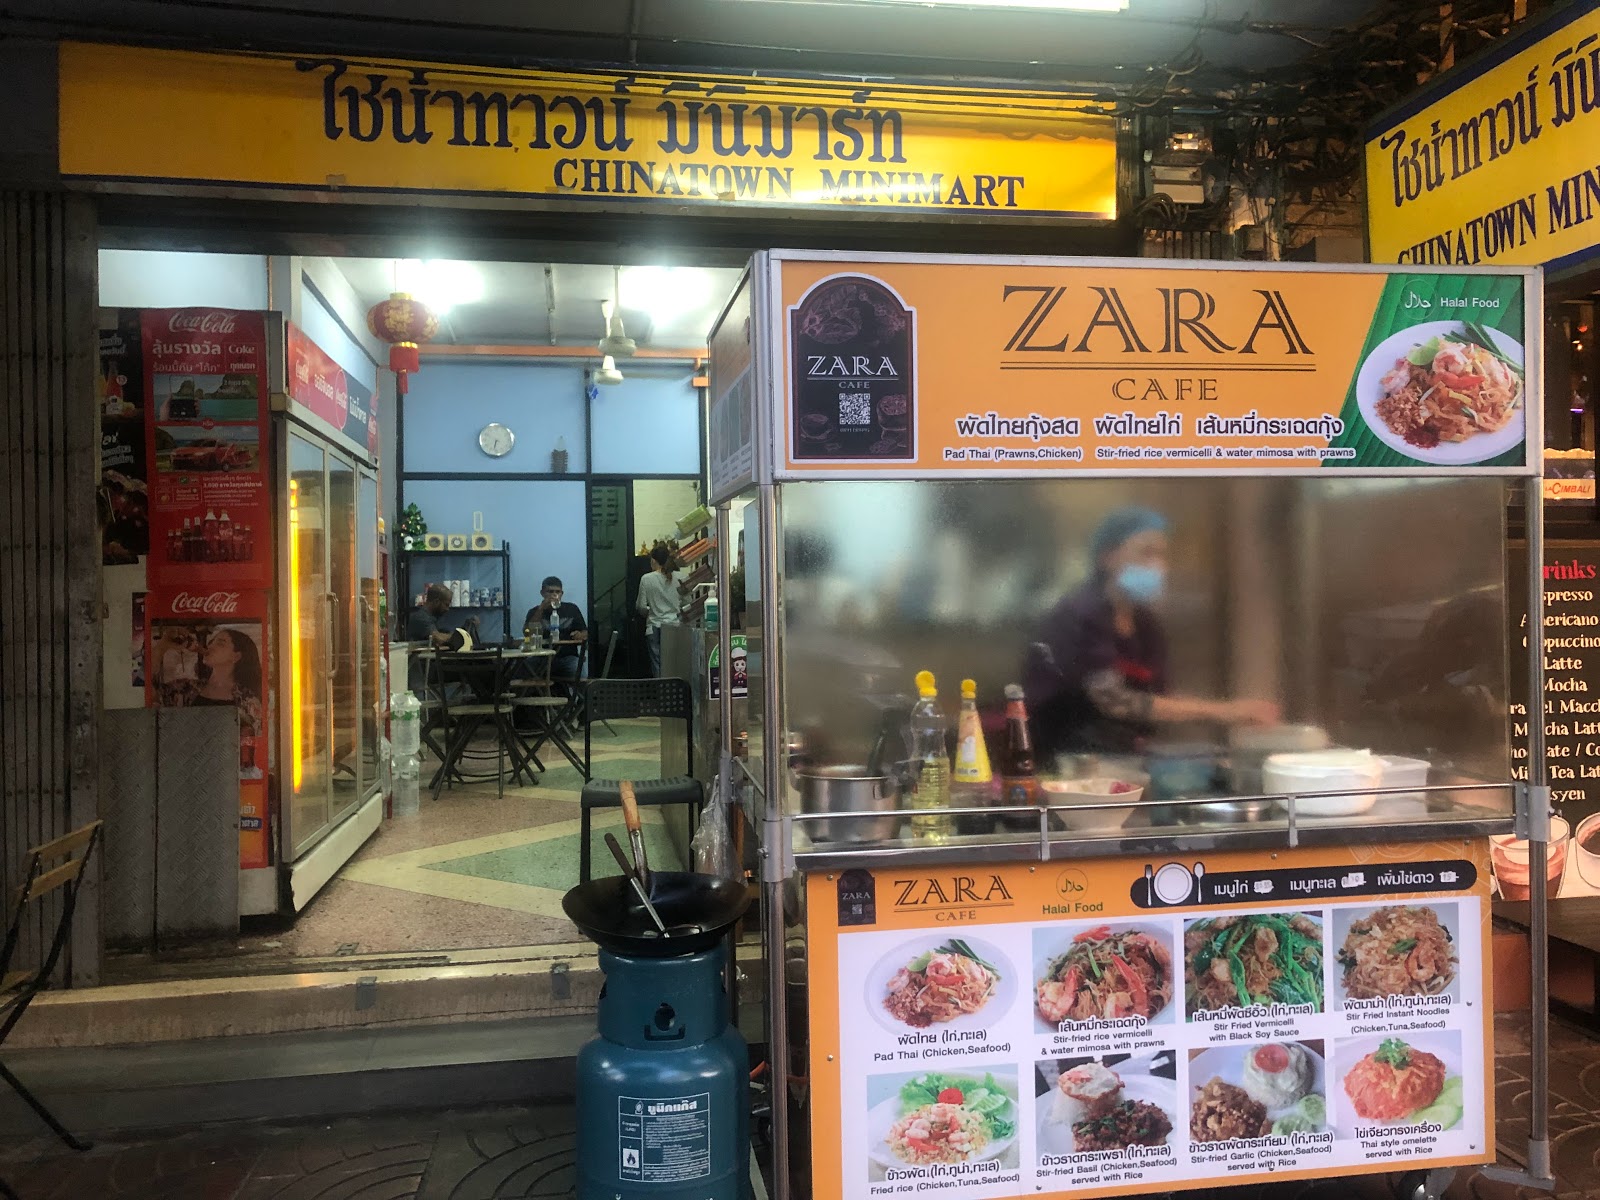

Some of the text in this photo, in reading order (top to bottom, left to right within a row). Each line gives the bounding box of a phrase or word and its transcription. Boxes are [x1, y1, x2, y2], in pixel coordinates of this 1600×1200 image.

[295, 58, 907, 163] ไชน่าทาวน์ มินิมาร์ท
[1380, 64, 1543, 208] ไชน่าทาวน์
[553, 157, 1025, 208] CHINATOWN MINIMART
[1440, 297, 1500, 309] Halal Food
[169, 311, 240, 334] Coca-Cola
[1002, 284, 1316, 355] ZARA
[152, 339, 222, 358] ลุ้นรางวัล
[228, 344, 256, 355] Coke
[806, 355, 899, 376] ZARA
[838, 381, 871, 389] CAFE
[1111, 377, 1219, 401] CAFE
[957, 411, 1343, 440] ผัดไทยกุ้งสด ผัดไทยไก่ เส้นหมี่กระเฉดกุ้ง
[944, 448, 1082, 461] Pad Thai (Prawns,Chicken)
[1096, 448, 1354, 459] Stir-fried rice vermicelli & water mimosa with prawns
[1543, 559, 1597, 580] rinks
[171, 592, 240, 613] Coca-Cola
[1543, 590, 1594, 607] presso
[1520, 613, 1599, 628] ericano
[1522, 634, 1600, 653] puccino
[1544, 656, 1583, 671] Latte
[1513, 721, 1570, 737] Mcha
[1575, 742, 1581, 757] /
[1549, 765, 1576, 779] Tea
[1550, 788, 1586, 803] syen
[893, 874, 1014, 906] ZARA
[1214, 879, 1249, 898] เมนูไก่
[1289, 878, 1337, 894] เมนูทะเล
[1377, 869, 1435, 886] เพิ่มไข่ดาว
[842, 890, 871, 901] ZARA
[935, 910, 977, 922] CAFE
[1042, 901, 1104, 915] Halal Food
[1271, 1003, 1314, 1018] (ไก่,ทะเล)
[1344, 996, 1384, 1010] ผัดมาม่า
[1346, 1007, 1450, 1021] Stir Fried Instant Noodles
[1060, 1016, 1147, 1033] เส้นหมี่กระเฉดกุ้ง
[1213, 1018, 1295, 1031] Stir Fried Vermicelli
[1350, 1020, 1446, 1034] (Chicken,Tuna,Seafood)
[897, 1029, 988, 1046] ผัดไทย (ไก่,ทะเล)
[1053, 1029, 1153, 1044] Stir-fried rice vermicelli
[1208, 1028, 1300, 1042] with Black Soy Sauce
[873, 1043, 1012, 1062] Pad Thai (Chicken,Seafood)
[1041, 1039, 1166, 1056] & water mimosa with prawns
[1354, 1120, 1442, 1139] ไข่เจียวทรงเครื่อง
[1189, 1132, 1334, 1153] ข้าวราดผัดกระเทียม (ไก่,ทะเล)
[1360, 1136, 1438, 1149] Thai style omelette
[1042, 1145, 1172, 1166] ข้าวราดกระเพรา (ไก่,ทะเล)
[1191, 1145, 1333, 1164] Stir-fried Garlic (Chicken,Seafood)
[1365, 1146, 1433, 1159] served with Rice
[1036, 1158, 1178, 1178] Stir-fried Basil (Chicken,Seafood)
[1227, 1158, 1297, 1171] served with Rice
[887, 1167, 926, 1181] ข้าวผัด
[1071, 1171, 1143, 1185] served with Rice
[870, 1173, 1020, 1195] Fried rice (Chicken,Tuna,Seafood)
